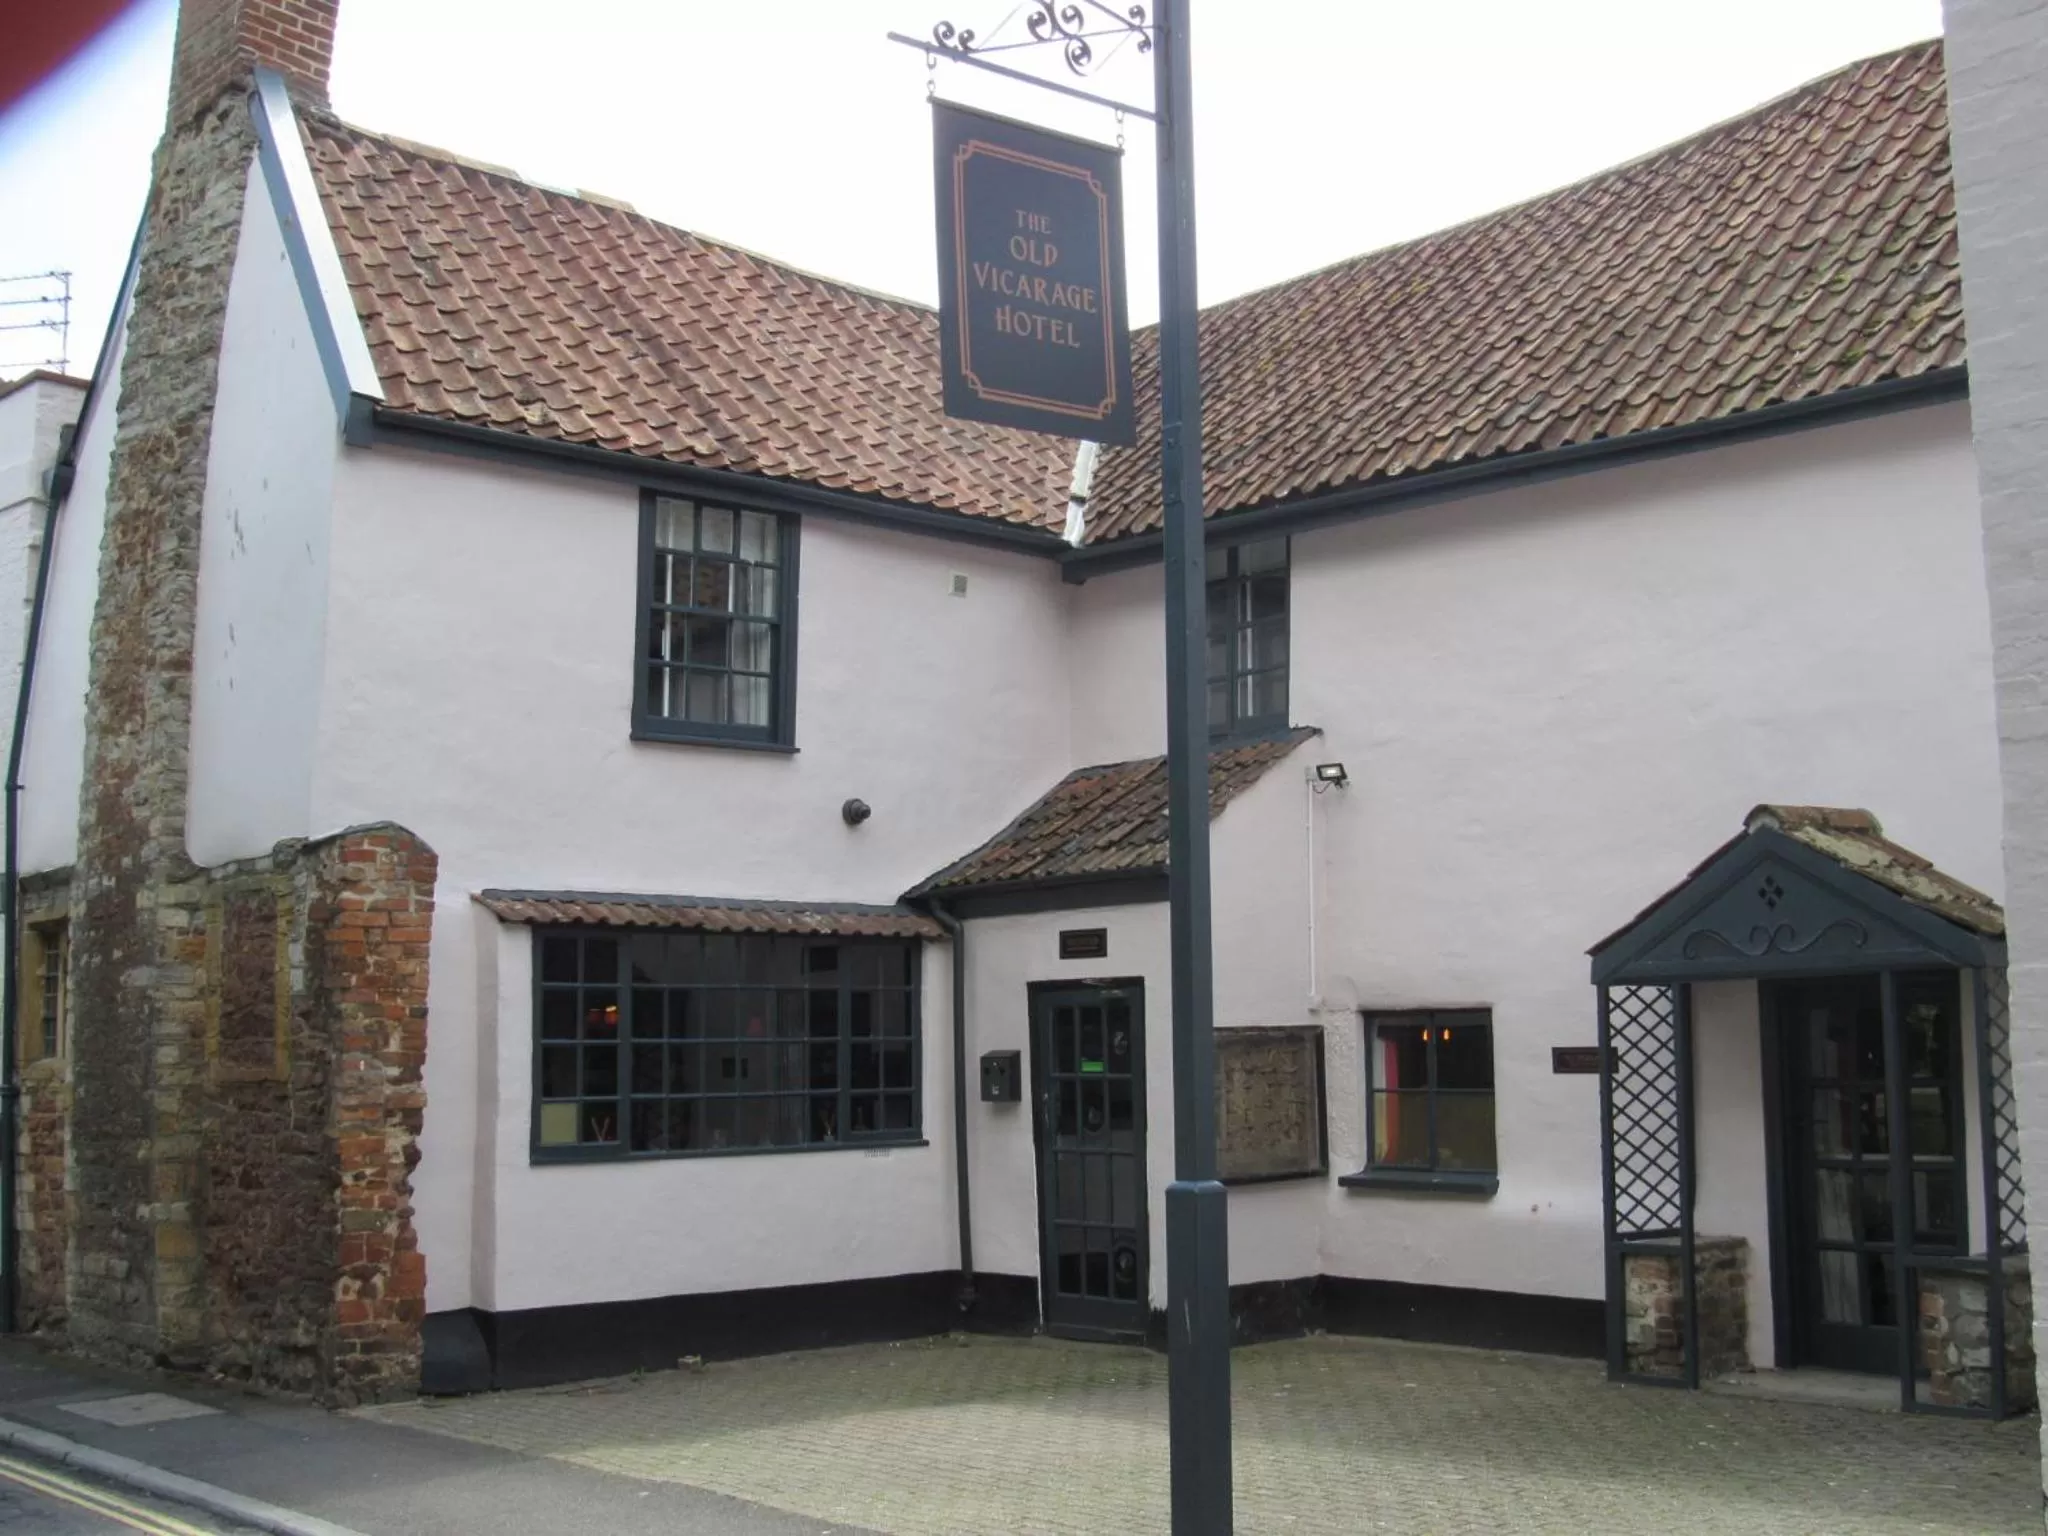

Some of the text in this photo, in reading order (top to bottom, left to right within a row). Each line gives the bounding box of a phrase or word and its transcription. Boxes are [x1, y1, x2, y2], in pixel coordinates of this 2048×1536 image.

[1016, 210, 1051, 234] THE
[1010, 235, 1058, 267] OLD
[973, 261, 1097, 313] VICARAGE
[995, 304, 1080, 348] HOTEL
